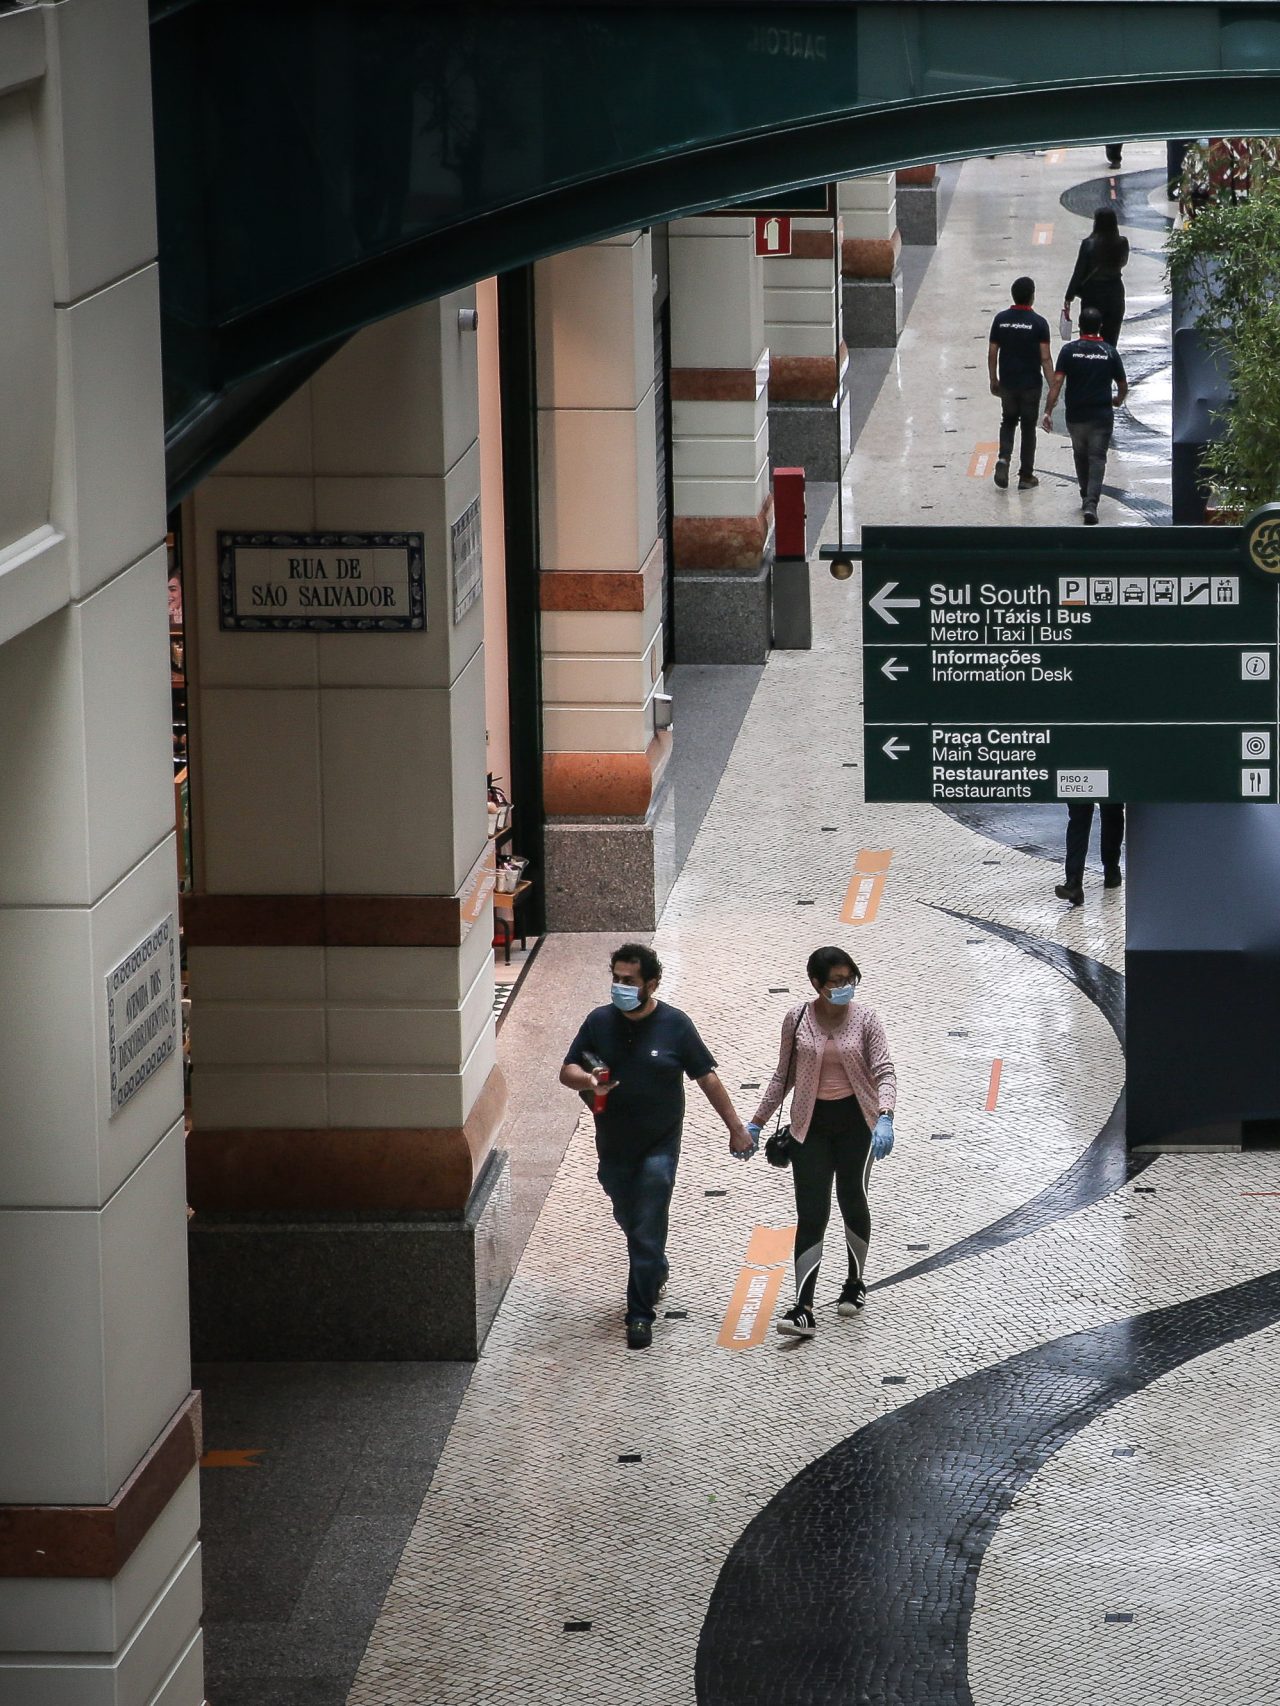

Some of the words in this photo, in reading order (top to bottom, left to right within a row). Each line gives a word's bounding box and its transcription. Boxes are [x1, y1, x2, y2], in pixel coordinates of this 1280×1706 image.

[287, 558, 328, 580] RUA
[335, 558, 362, 580] DE
[251, 583, 288, 607] SÃO
[298, 585, 397, 607] SALVADOR
[929, 583, 971, 605] Sul
[979, 583, 1051, 605] South
[930, 609, 981, 624] Metro
[994, 608, 1041, 624] Táxis
[1057, 609, 1092, 624] Bus
[931, 626, 979, 641] Metro
[993, 626, 1025, 641] Taxi
[1040, 626, 1073, 641] Bus
[932, 649, 1042, 668] Informações
[932, 665, 1025, 682] Information
[1031, 666, 1073, 682] Desk
[932, 729, 981, 748] Praça
[987, 729, 1051, 744] Central
[932, 746, 972, 762] Main
[977, 747, 1037, 765] Square
[932, 766, 1049, 781] Restaurantes
[1060, 775, 1082, 783] PISO
[1083, 775, 1089, 783] 2
[932, 783, 1032, 798] Restaurants
[1060, 784, 1087, 793] LEVEL
[1087, 784, 1094, 793] 2
